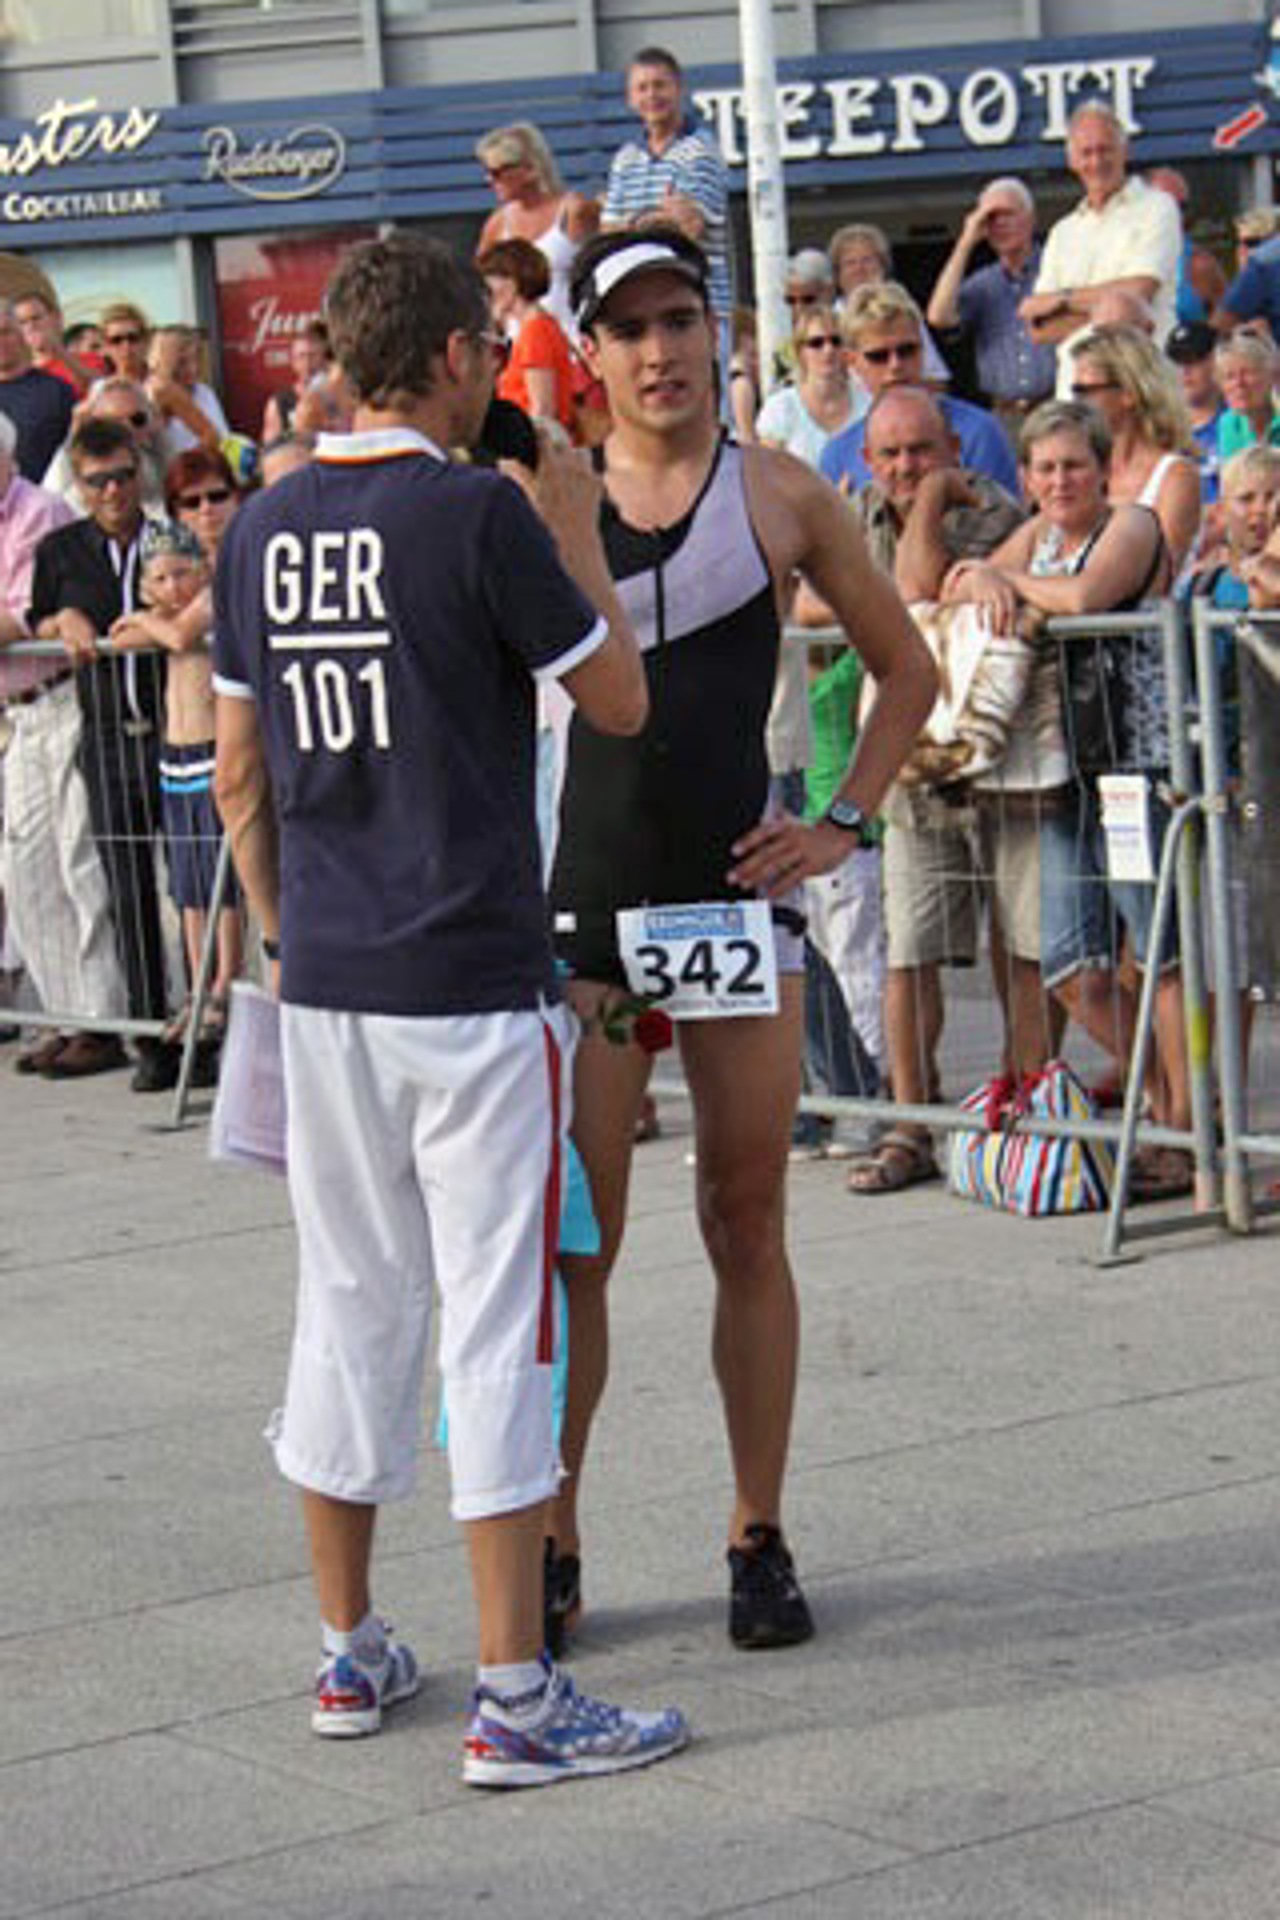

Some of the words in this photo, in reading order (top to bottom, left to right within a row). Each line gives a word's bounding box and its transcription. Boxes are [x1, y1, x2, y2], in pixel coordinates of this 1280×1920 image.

[692, 57, 1156, 165] TEEPOTT
[263, 527, 387, 625] GER
[281, 657, 391, 754] 101
[635, 939, 765, 999] 342
